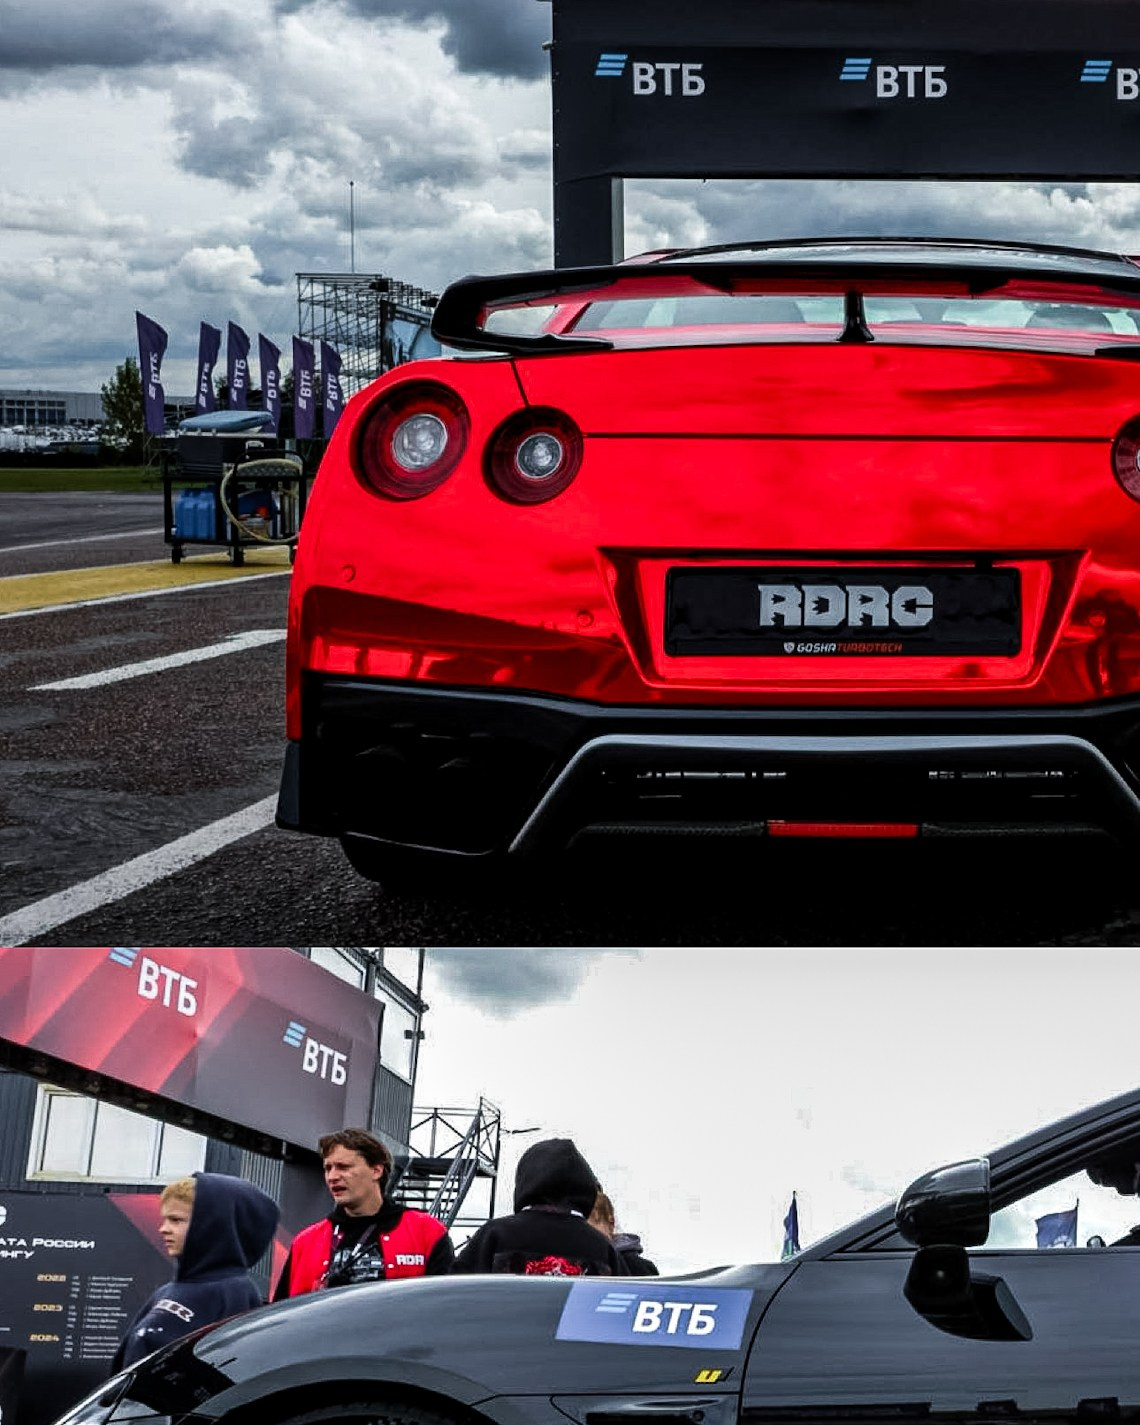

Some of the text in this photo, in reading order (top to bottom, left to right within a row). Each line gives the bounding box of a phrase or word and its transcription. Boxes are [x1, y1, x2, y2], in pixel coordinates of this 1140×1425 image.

[633, 62, 706, 96] ВТБ
[876, 66, 948, 99] ВТБ
[758, 584, 934, 627] RDRC
[137, 959, 199, 1017] ВТБ
[303, 1038, 348, 1087] ВТБ
[633, 1300, 717, 1336] ВТБ
